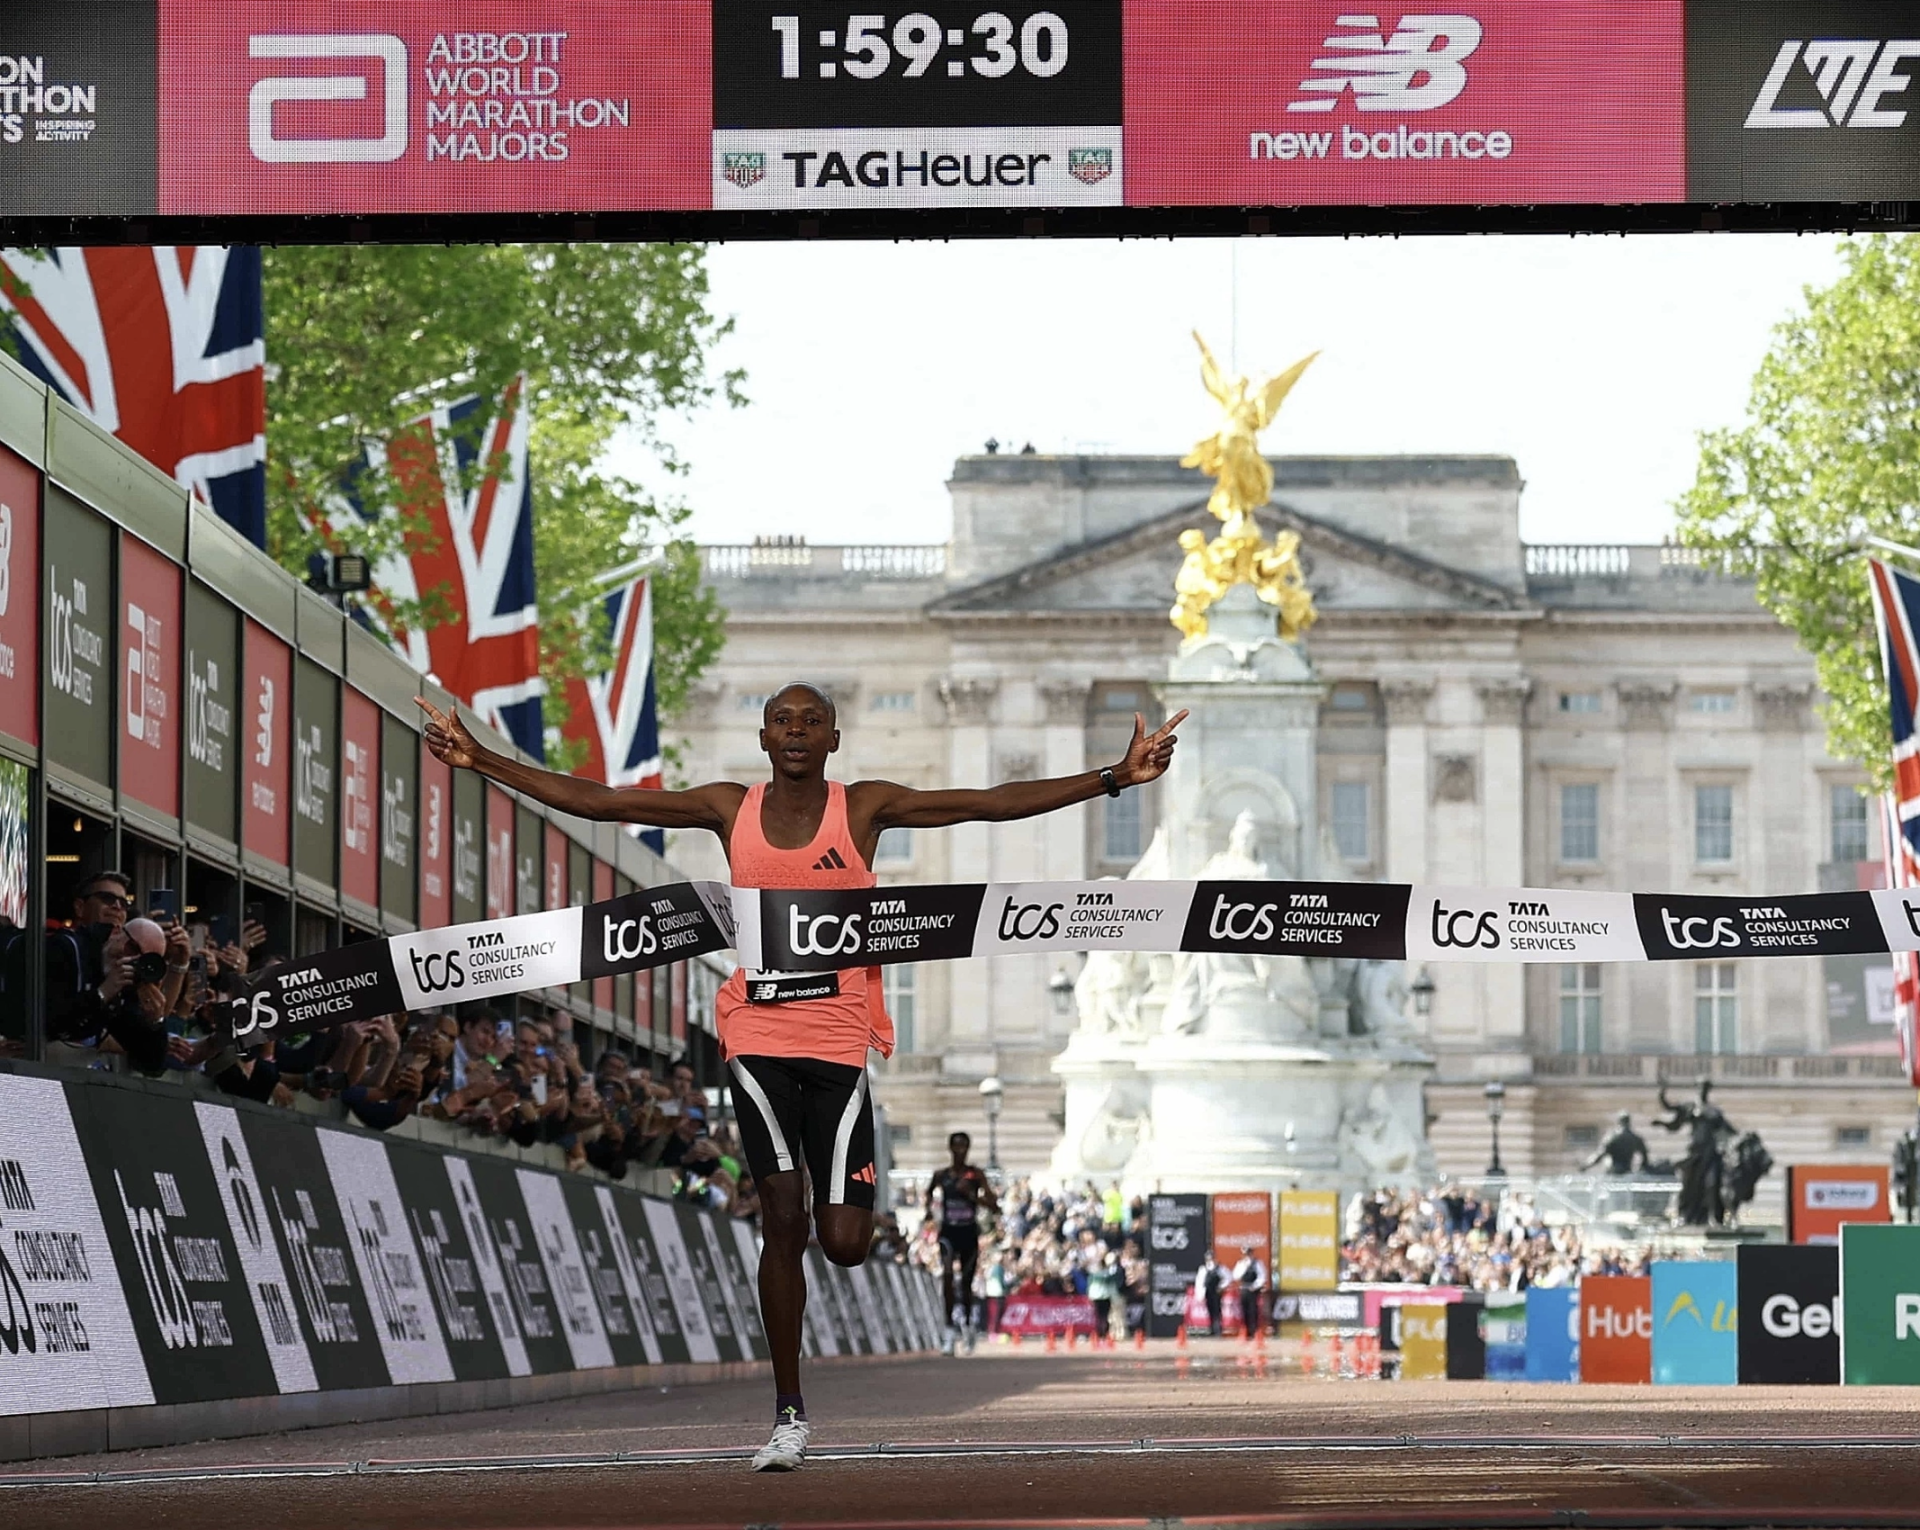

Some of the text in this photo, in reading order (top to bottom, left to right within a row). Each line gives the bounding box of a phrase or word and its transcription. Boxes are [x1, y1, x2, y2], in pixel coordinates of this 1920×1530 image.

[426, 33, 567, 63] ABBOTT
[772, 12, 1068, 79] 1:59:30
[426, 67, 559, 97] WORLD
[427, 99, 629, 127] MARATHON
[427, 131, 568, 161] MAJORS
[1250, 125, 1512, 159] new balance
[650, 899, 675, 916] TATA
[870, 900, 906, 915] TATA
[1076, 893, 1113, 906] TATA
[1289, 895, 1328, 909] TATA
[1508, 901, 1550, 917] TATA
[657, 909, 704, 933] CONSULTANCY
[997, 895, 1064, 941] tcs
[1069, 907, 1164, 924] CONSULTANCY
[1208, 899, 1275, 941] tcs
[1283, 909, 1381, 927] CONSULTANCY
[1432, 899, 1500, 949] tcs
[1739, 906, 1787, 920] TATA
[790, 904, 862, 956] tcs
[868, 913, 955, 936] CONSULTANCY
[1064, 923, 1124, 940] SERVICES
[1280, 927, 1344, 944] SERVICES
[1508, 918, 1609, 936] CONSULTANCY
[1661, 907, 1741, 949] tcs
[1744, 916, 1851, 935] CONSULTANCY
[467, 932, 505, 949] TATA
[604, 914, 657, 962] tcs
[661, 929, 699, 951] SERVICES
[866, 933, 920, 953] SERVICES
[1509, 935, 1577, 951] SERVICES
[1749, 931, 1818, 948] SERVICES
[469, 941, 556, 968] CONSULTANCY
[277, 968, 323, 989] TATA
[409, 947, 464, 994] tcs
[472, 964, 524, 986] SERVICES
[282, 971, 379, 1006] CONSULTANCY
[778, 990, 795, 999] new
[796, 986, 830, 997] balance
[287, 995, 354, 1023] SERVICES
[113, 1168, 198, 1349] tcs
[35, 1302, 90, 1352] SERVICES
